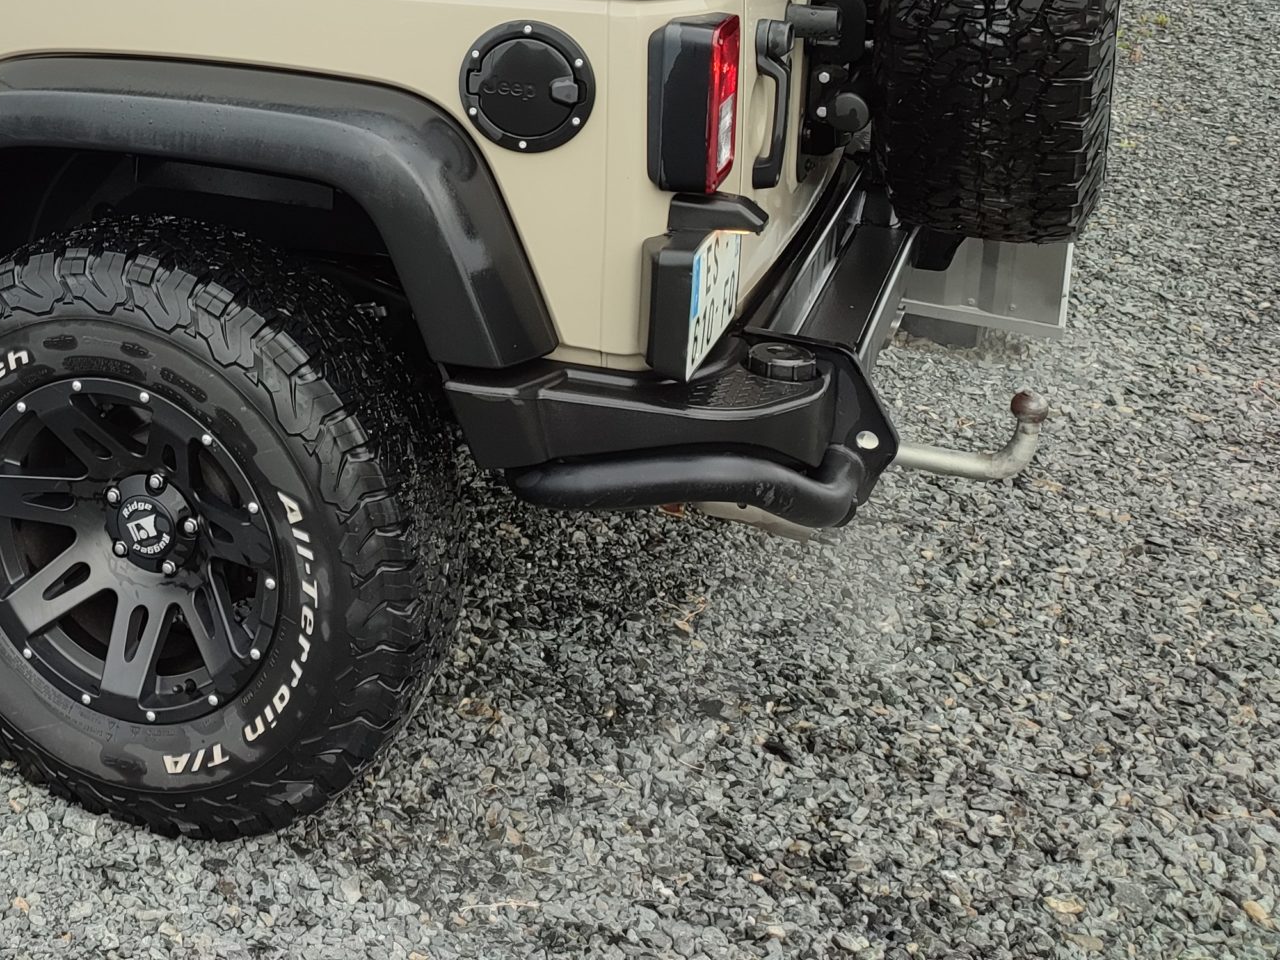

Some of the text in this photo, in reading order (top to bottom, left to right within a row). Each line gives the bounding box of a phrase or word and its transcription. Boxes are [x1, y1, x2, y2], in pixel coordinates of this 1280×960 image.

[483, 76, 537, 101] Jeep
[122, 500, 153, 519] Ridge
[132, 532, 171, 555] Rugged
[243, 490, 319, 742] All-Terrain
[162, 743, 230, 774] T/A
